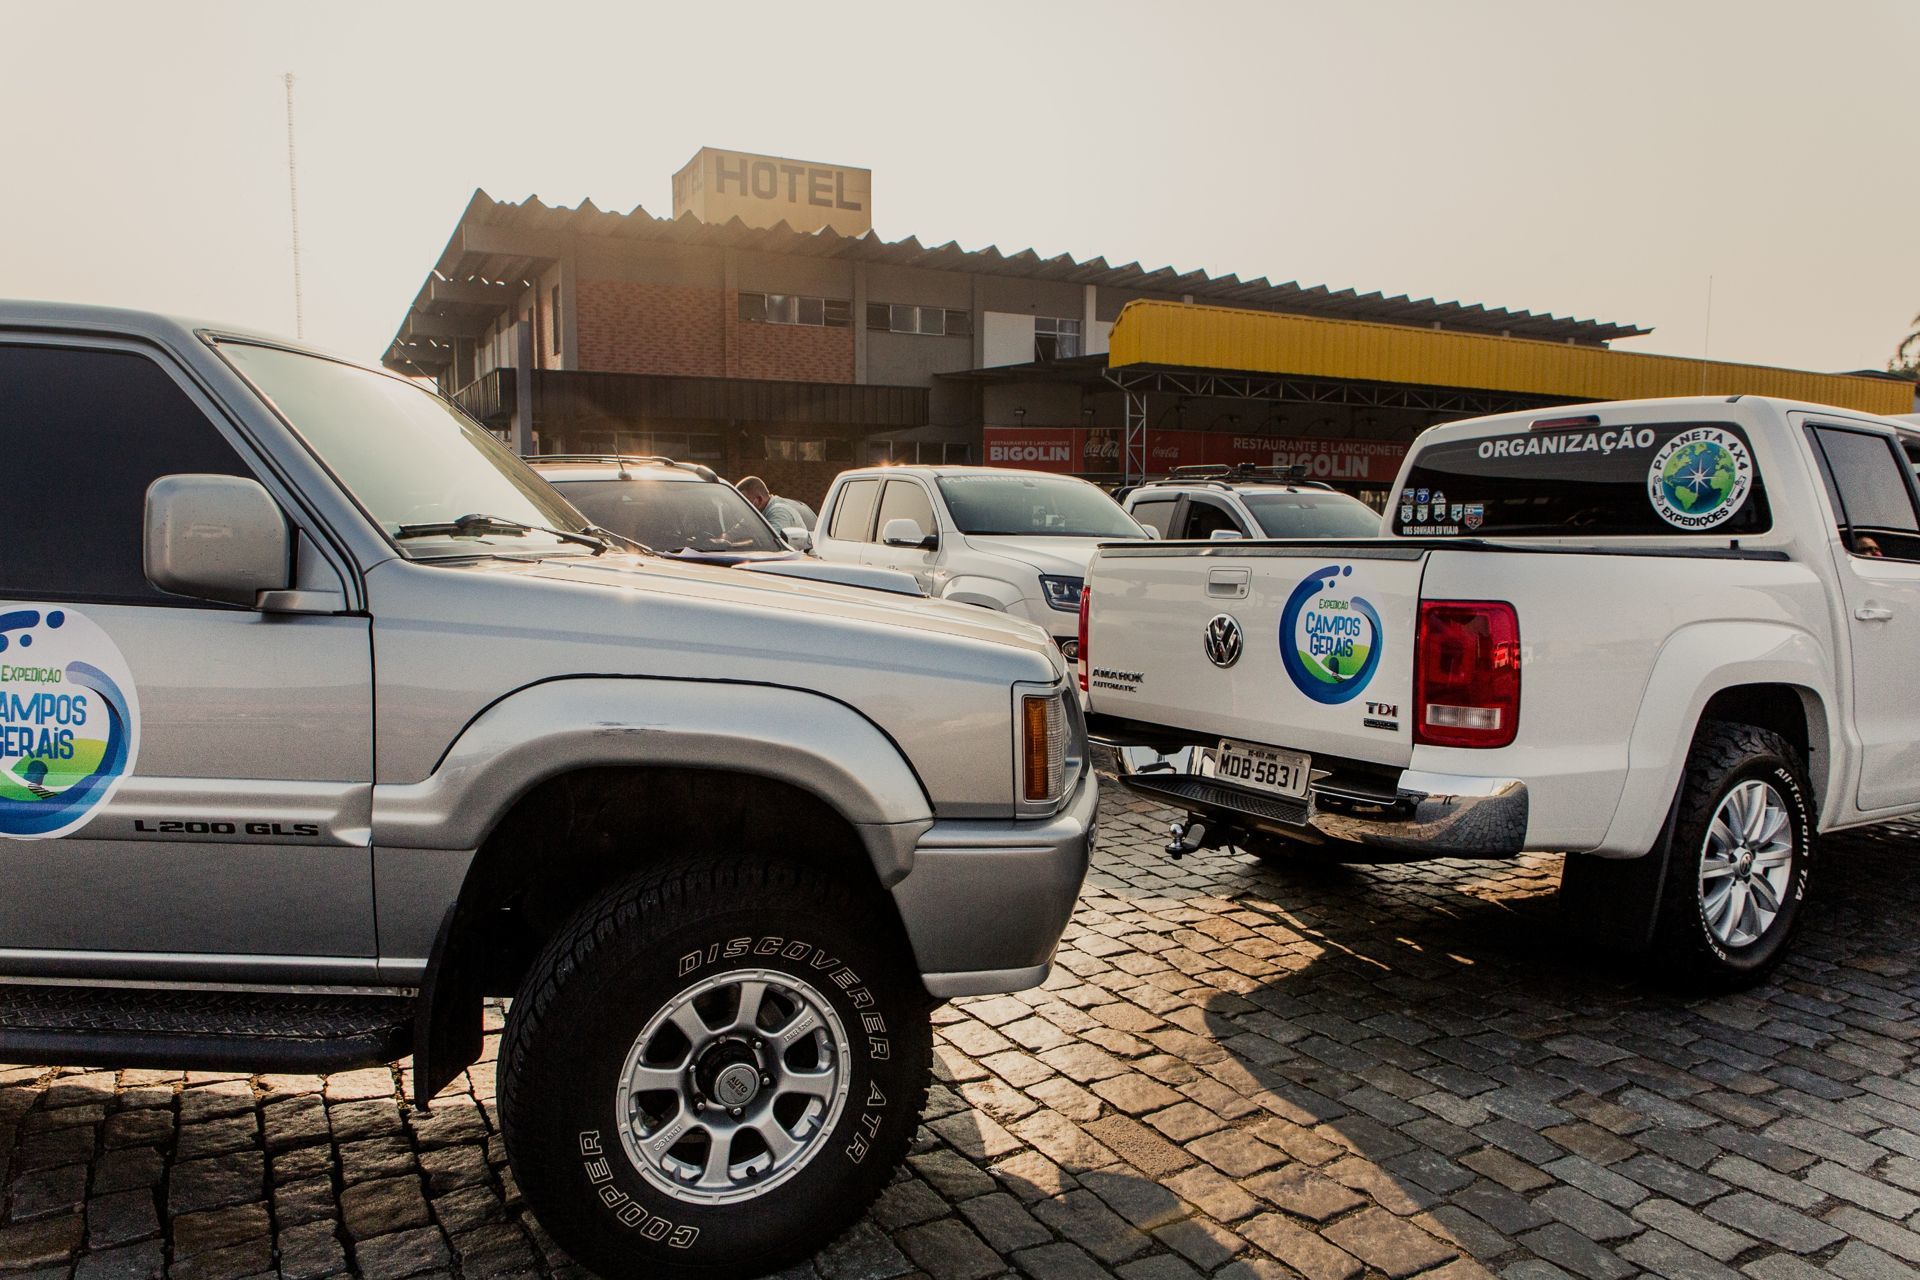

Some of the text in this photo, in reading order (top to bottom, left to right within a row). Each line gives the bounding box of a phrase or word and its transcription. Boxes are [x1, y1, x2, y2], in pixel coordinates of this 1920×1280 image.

[716, 156, 862, 211] HOTEL
[990, 446, 1070, 461] BIGOLIN
[1233, 437, 1404, 456] RESTAURANTE E LANCHONETE
[1478, 427, 1655, 459] ORGANIZAÇÃO
[1654, 430, 1724, 470] PLANETA
[1662, 506, 1729, 527] EXPEDIÇÕES
[1305, 611, 1361, 637] CAMPOS
[1092, 667, 1145, 683] AMAROK
[1092, 680, 1137, 693] AUTOMATIC
[0, 691, 87, 726] AMPOS
[1365, 701, 1399, 717] TDI
[134, 819, 319, 836] L200 GLS
[678, 936, 890, 1164] DISCOVERER ATR
[730, 1076, 748, 1093] AUTO
[579, 1130, 700, 1249] COOPER
